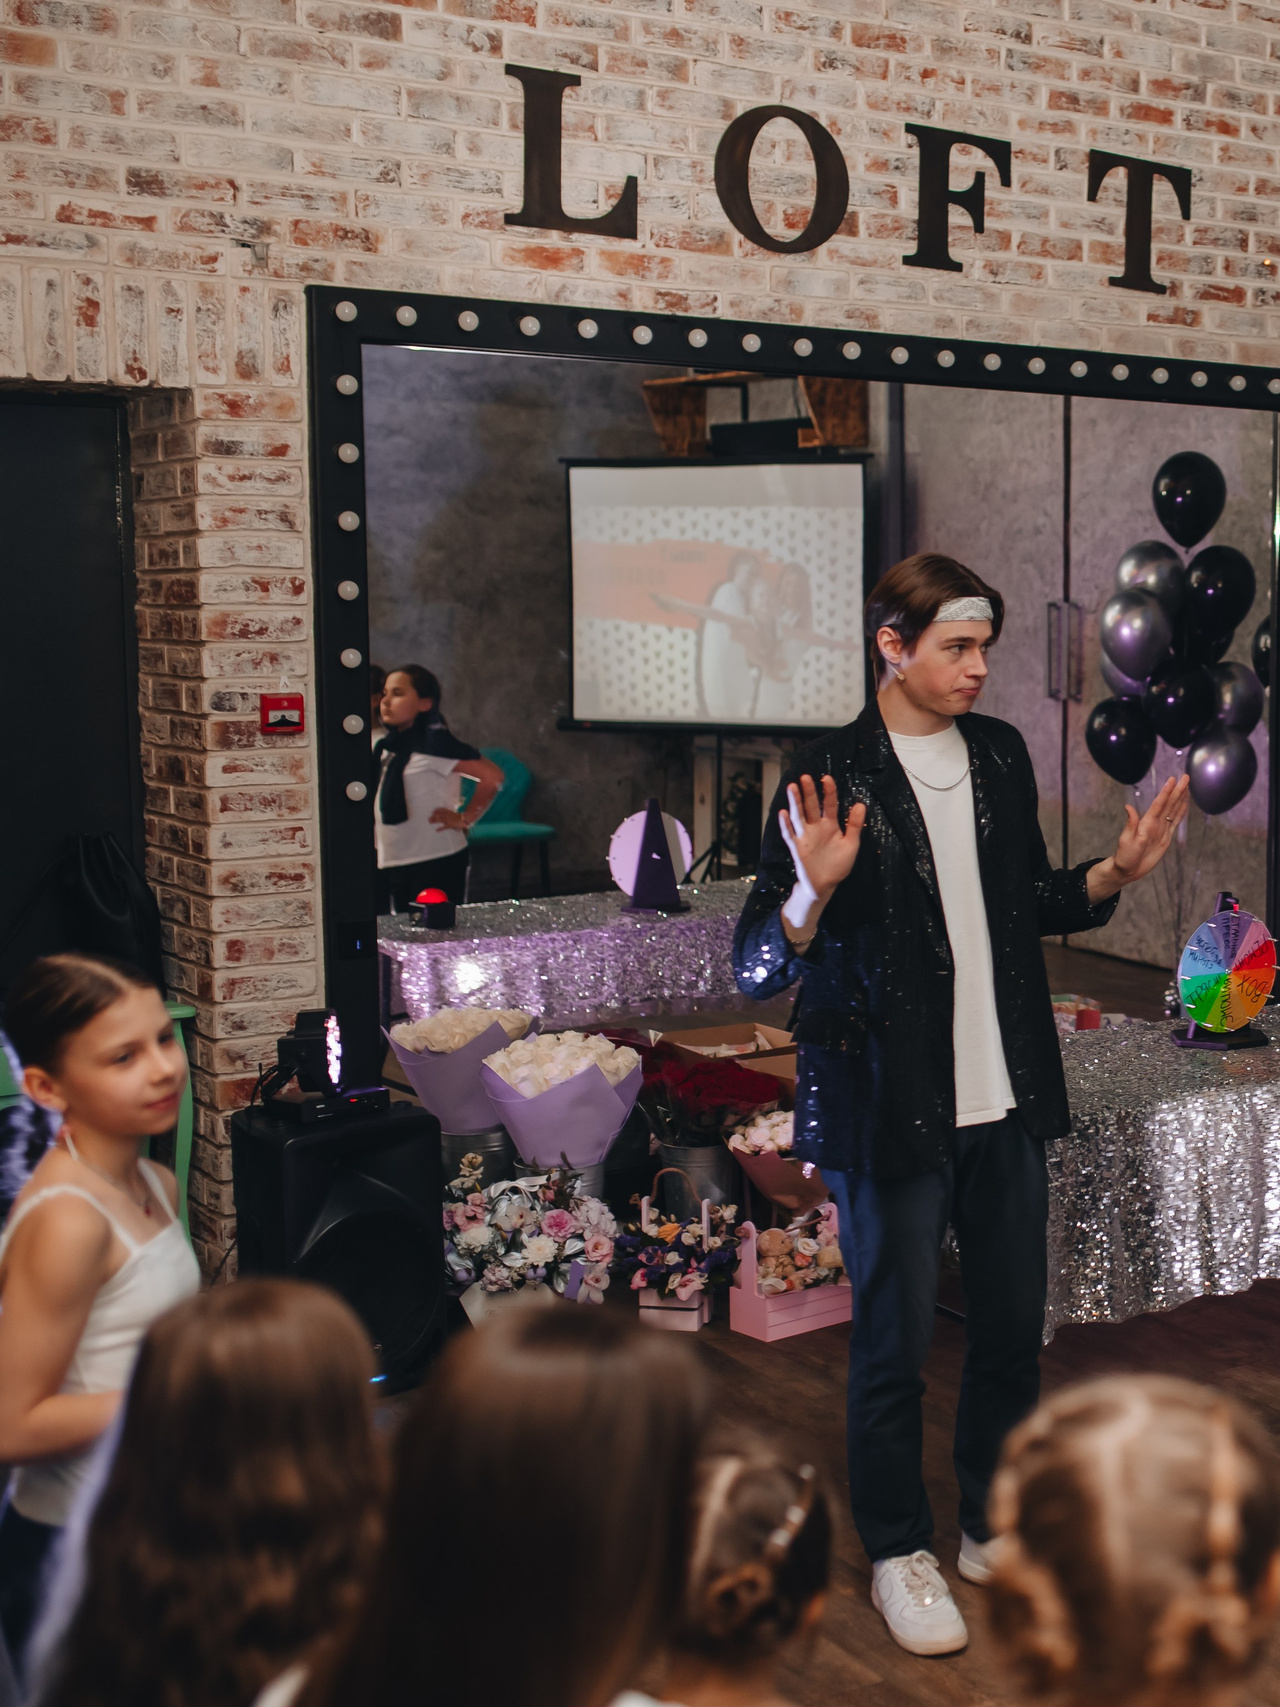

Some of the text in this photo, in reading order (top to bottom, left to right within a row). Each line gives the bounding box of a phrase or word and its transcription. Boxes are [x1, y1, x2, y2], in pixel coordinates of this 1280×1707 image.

[503, 63, 1193, 295] LOFT
[1234, 933, 1269, 971] РЕМОНТ
[1219, 977, 1234, 1027] ЭМОЦИЯ
